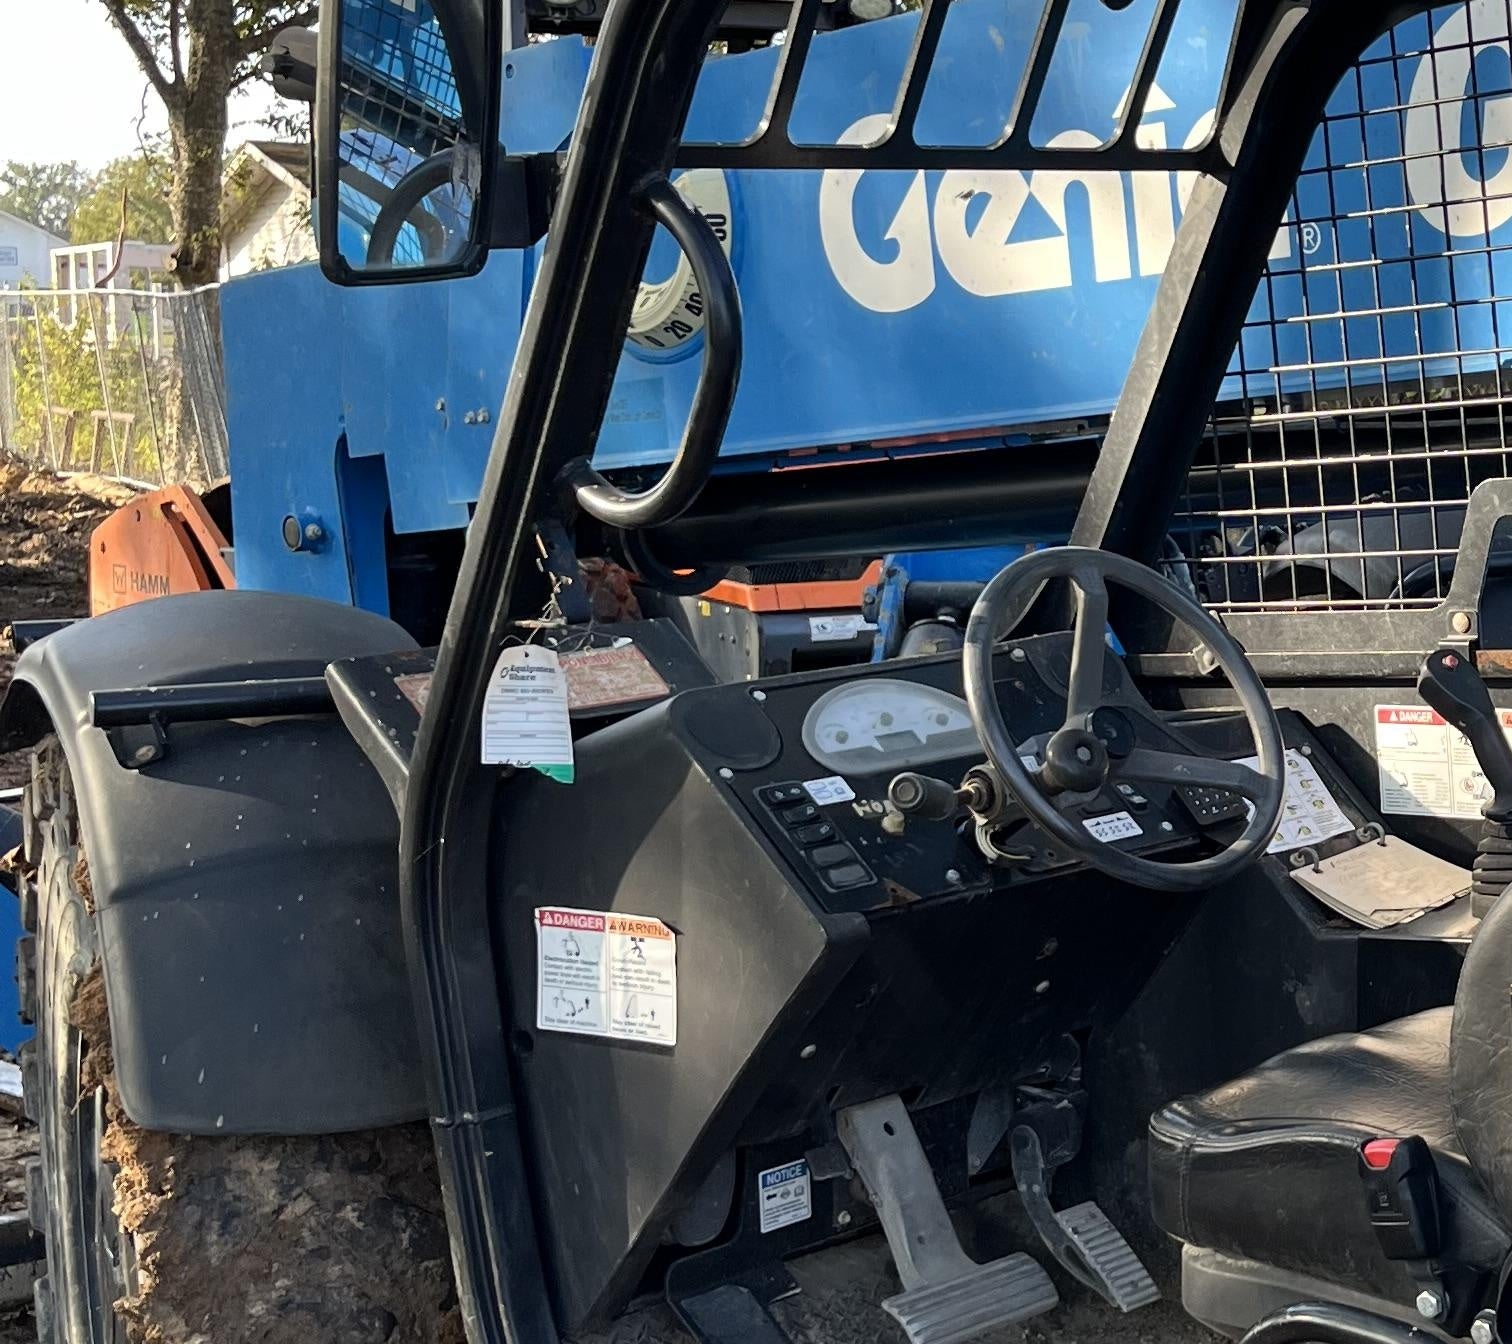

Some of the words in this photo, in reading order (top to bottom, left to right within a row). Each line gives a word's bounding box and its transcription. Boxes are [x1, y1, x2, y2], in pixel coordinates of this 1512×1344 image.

[664, 320, 693, 341] 20
[131, 570, 170, 596] HAMM
[1399, 710, 1433, 723] DANGER
[554, 914, 604, 930] DANGER
[619, 919, 671, 937] WARNING
[766, 1164, 803, 1186] NOTICE
